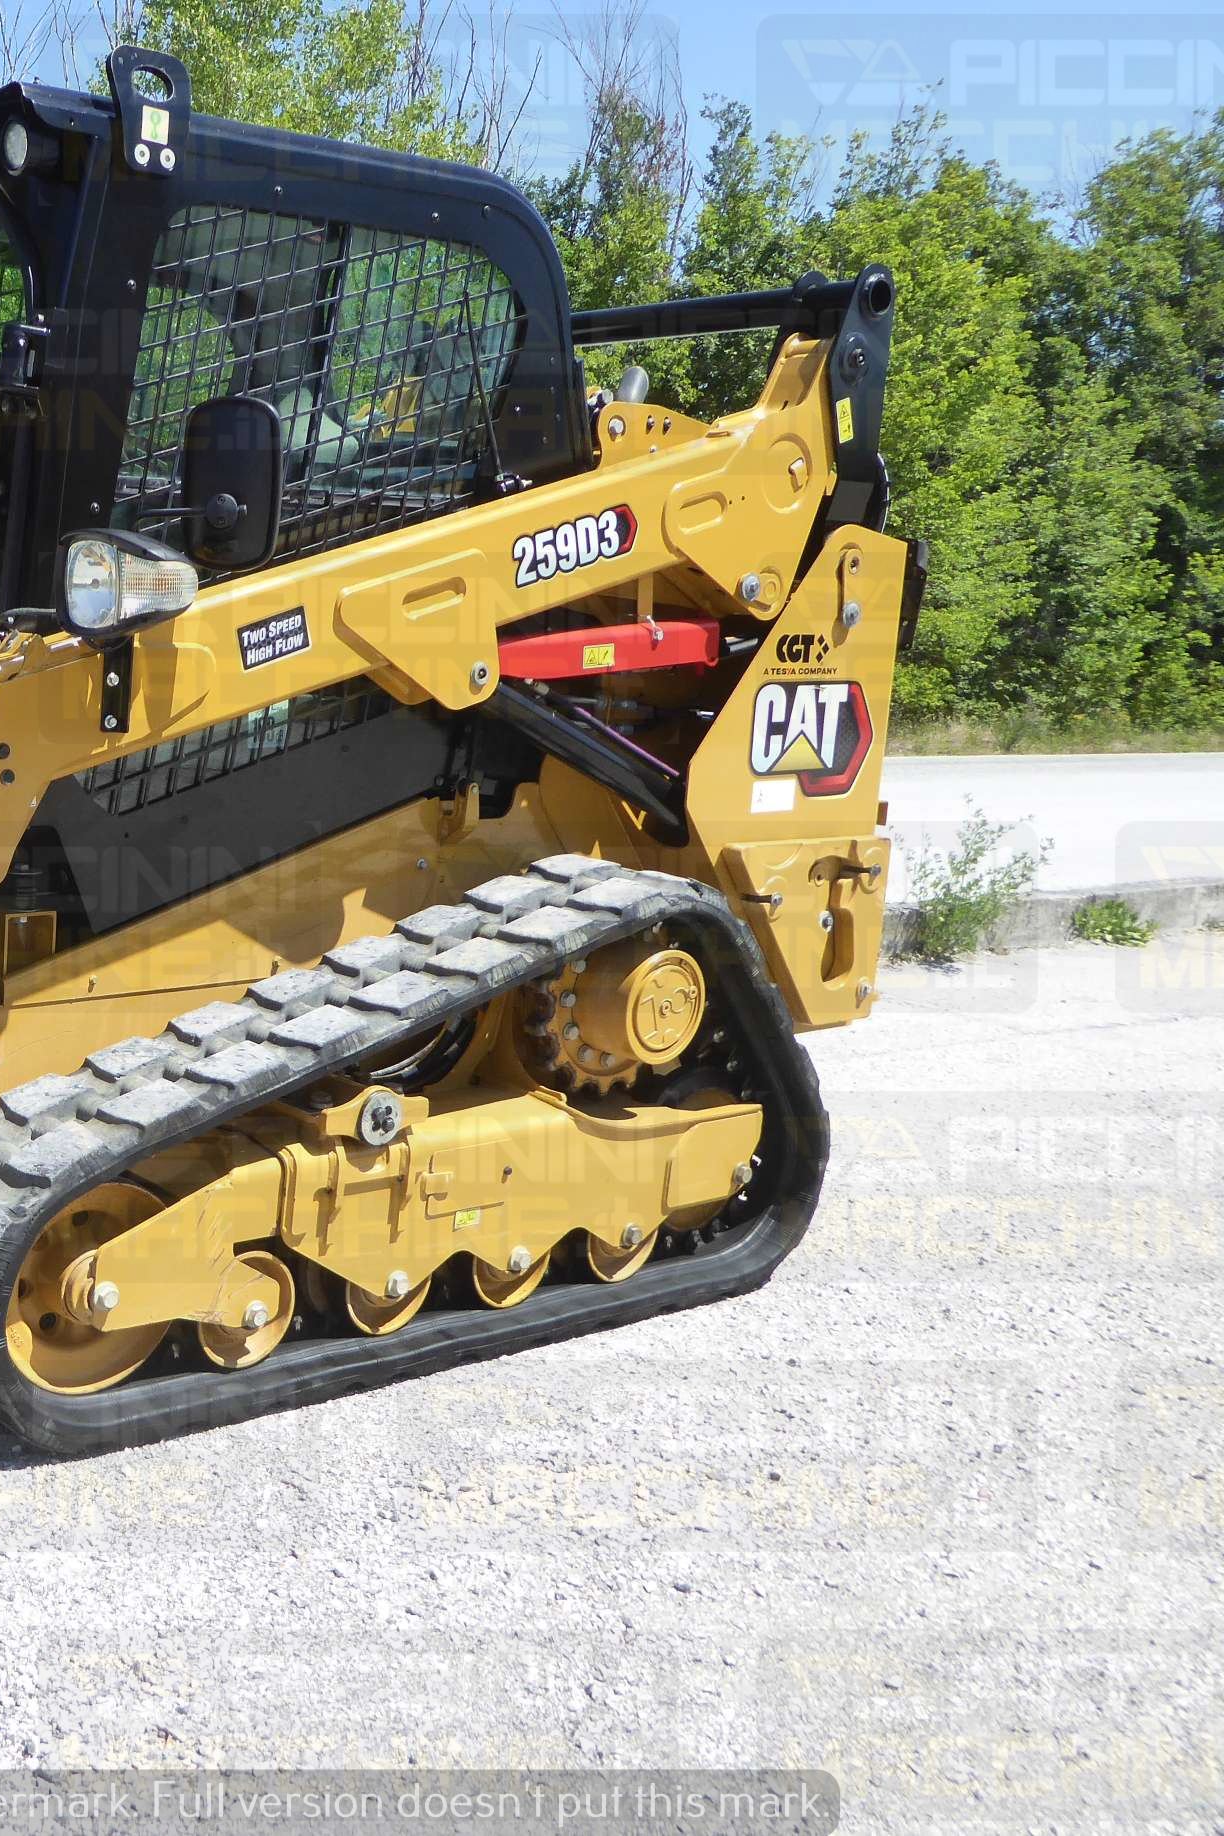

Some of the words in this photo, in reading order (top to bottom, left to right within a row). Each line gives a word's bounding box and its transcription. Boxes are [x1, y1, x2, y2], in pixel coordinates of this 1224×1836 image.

[513, 510, 619, 586] 259D3
[269, 614, 302, 638] SPEED
[246, 644, 273, 666] HIGH
[275, 632, 304, 655] FLOW
[776, 634, 815, 663] CGT
[798, 667, 837, 675] COMPANY
[751, 683, 849, 773] CAT
